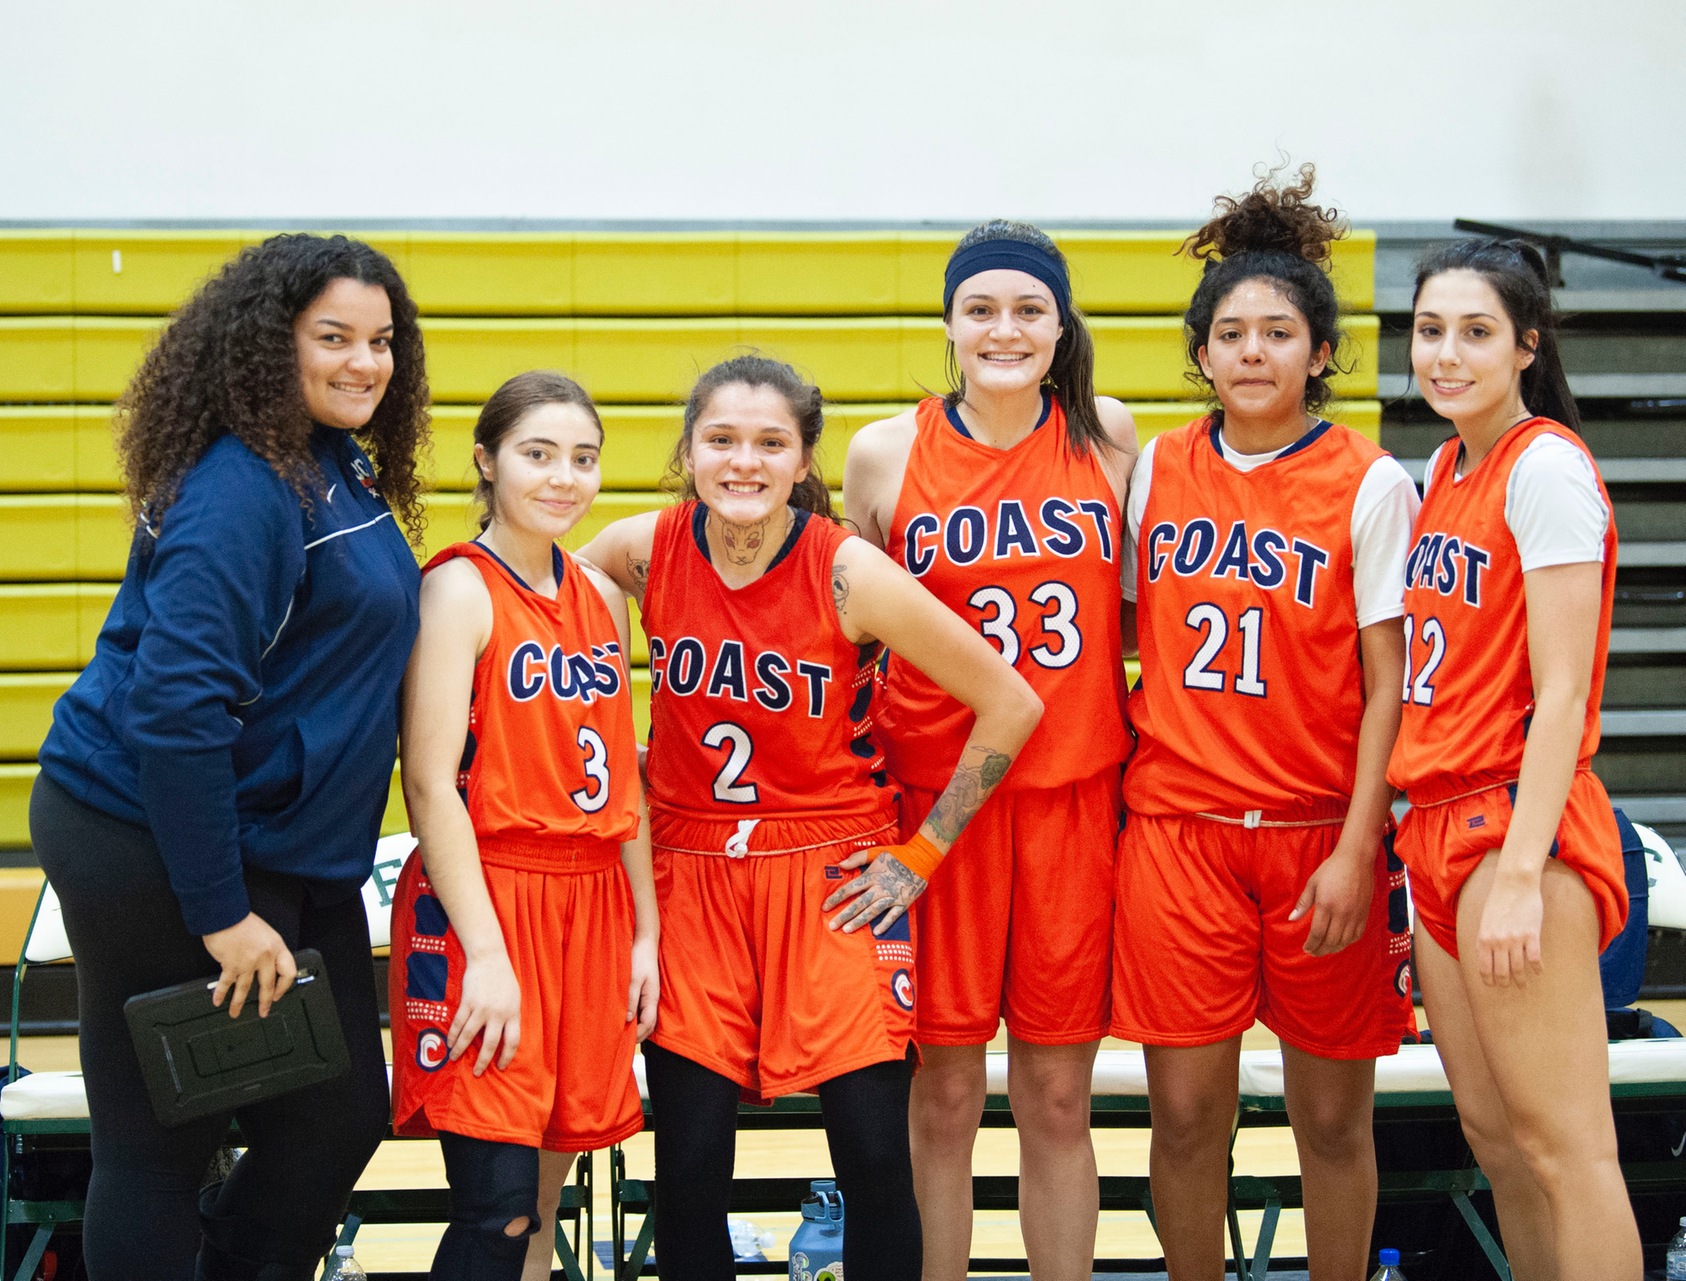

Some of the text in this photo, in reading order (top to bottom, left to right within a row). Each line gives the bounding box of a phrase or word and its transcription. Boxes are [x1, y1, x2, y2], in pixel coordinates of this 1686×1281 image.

[904, 497, 1113, 577] COAST
[1148, 517, 1329, 609] COAST
[1404, 532, 1490, 608] OAST
[967, 580, 1083, 670] 33
[1183, 601, 1267, 699] 21
[570, 725, 610, 814] 3
[701, 720, 760, 804] 2
